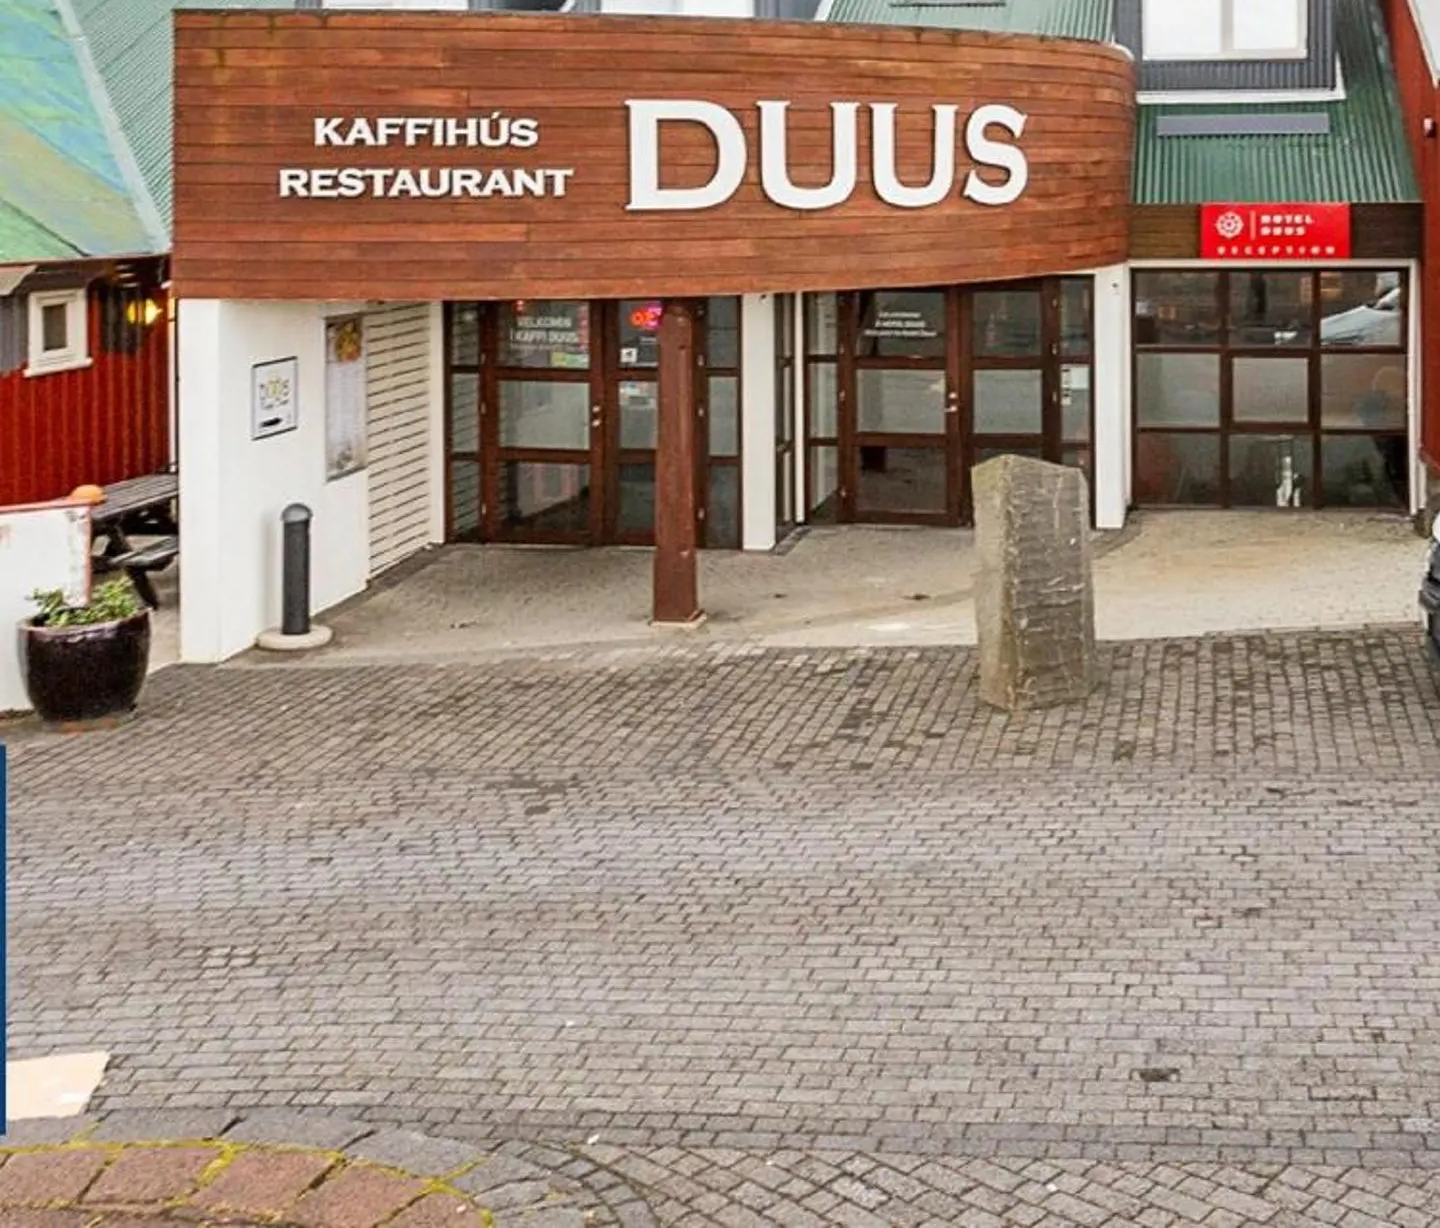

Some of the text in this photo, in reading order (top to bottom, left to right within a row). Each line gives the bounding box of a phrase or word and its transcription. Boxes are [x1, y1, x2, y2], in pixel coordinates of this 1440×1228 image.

[313, 111, 539, 148] KAFFIHÚS
[624, 98, 1029, 211] DUUS
[279, 167, 575, 199] RESTAURANT
